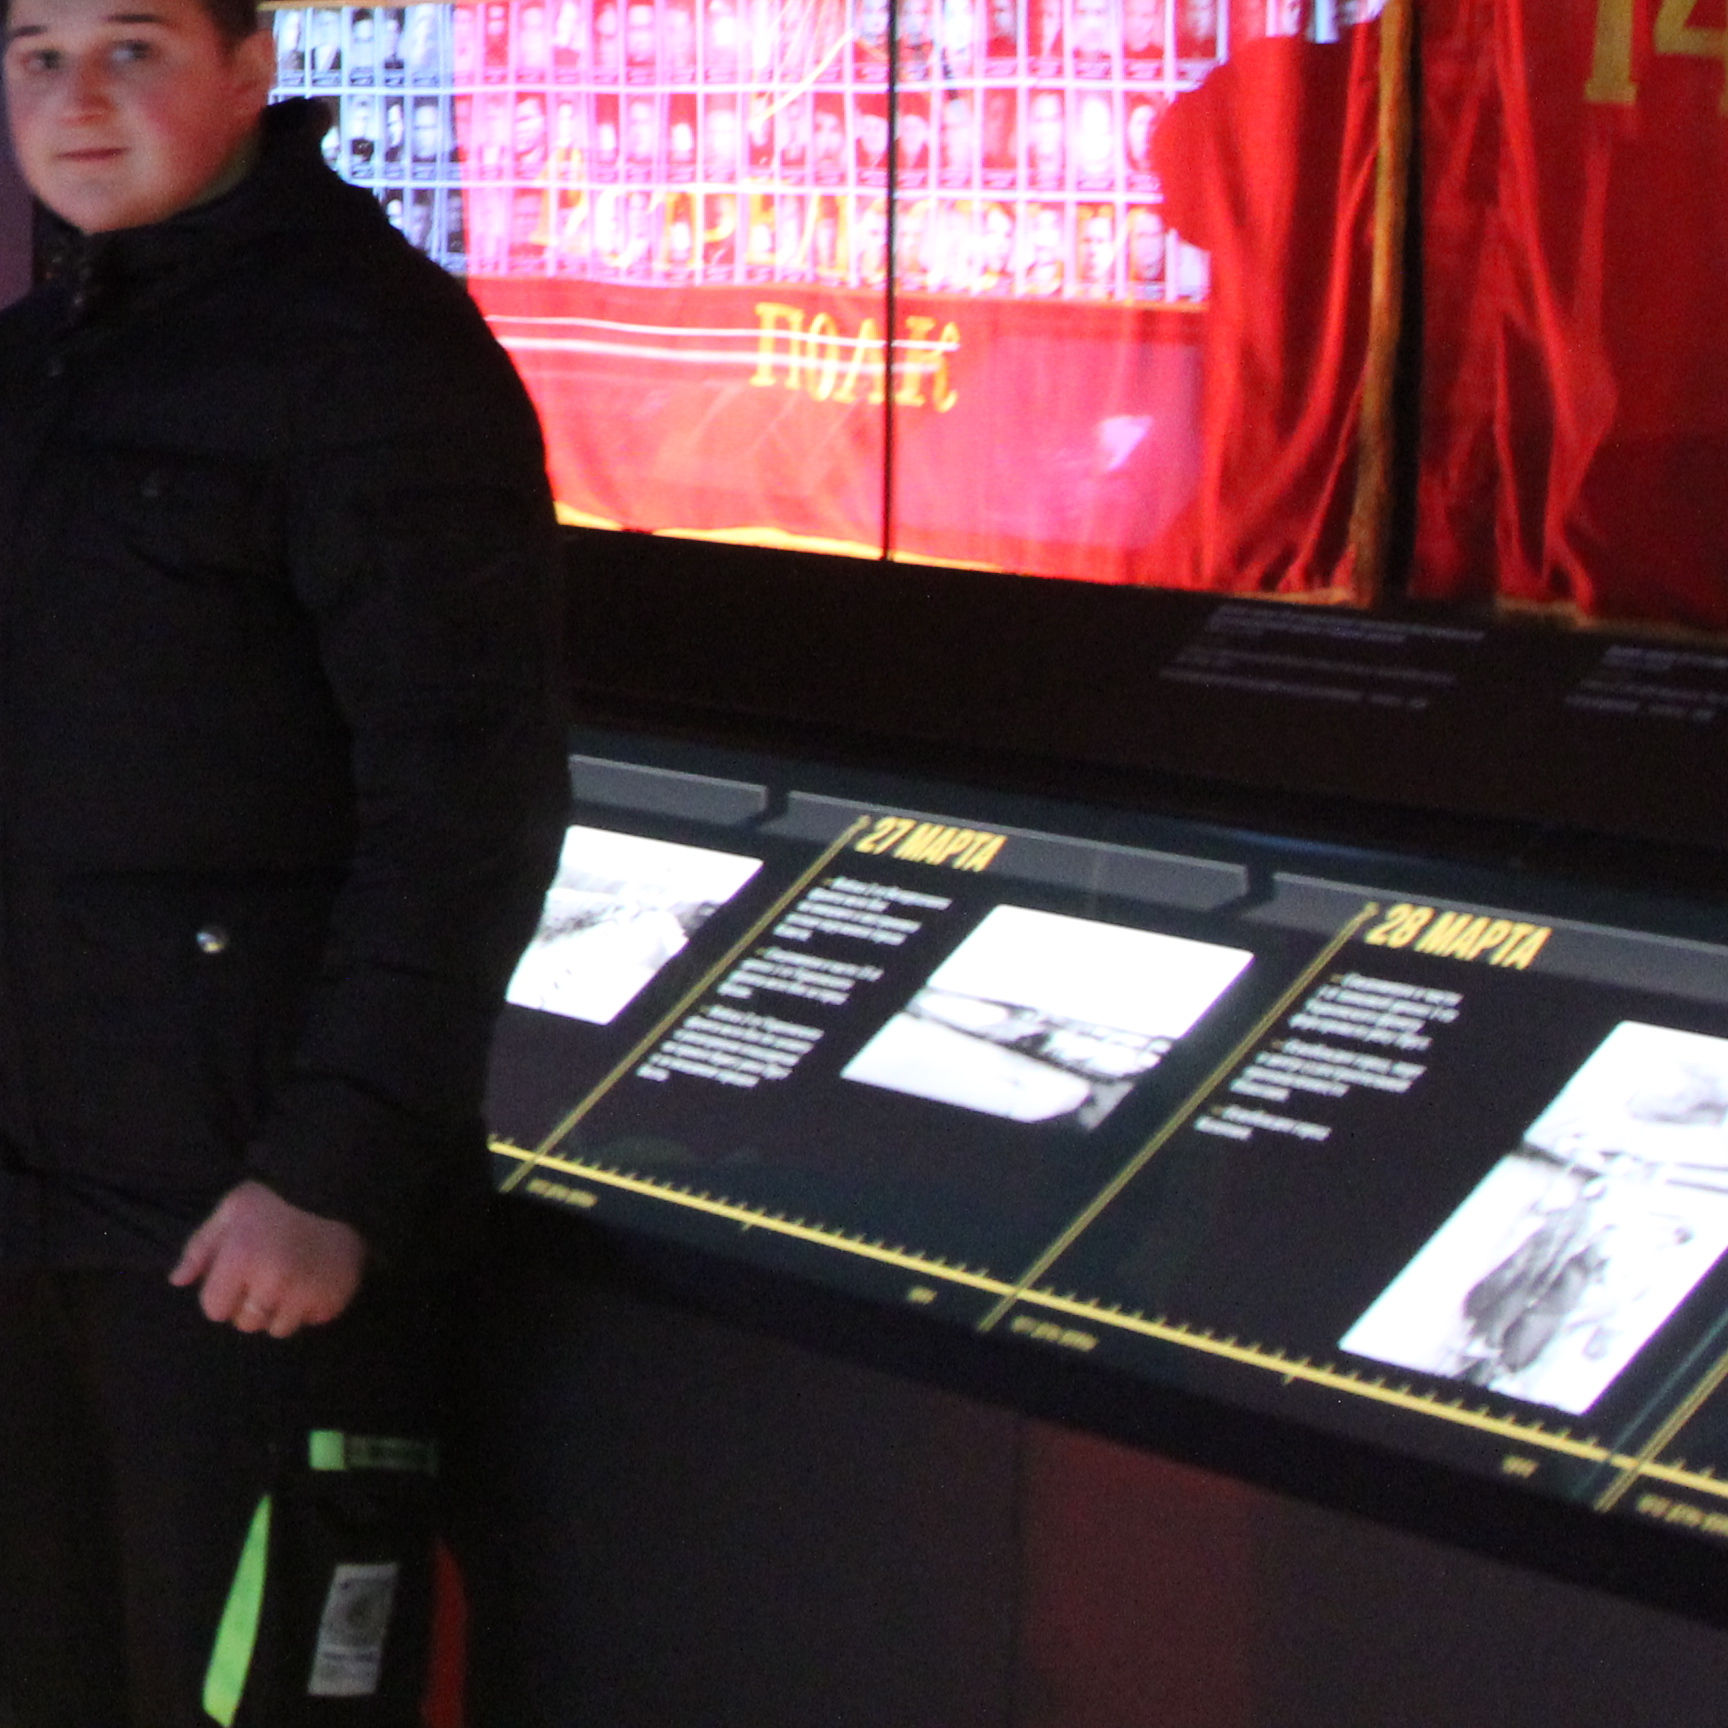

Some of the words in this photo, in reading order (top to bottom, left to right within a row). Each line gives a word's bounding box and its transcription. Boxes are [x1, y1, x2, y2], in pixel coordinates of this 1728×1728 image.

[853, 815, 918, 856] 27
[893, 821, 1008, 874] МАРТА
[1364, 902, 1437, 949] 28
[1413, 910, 1554, 971] МАРТА
